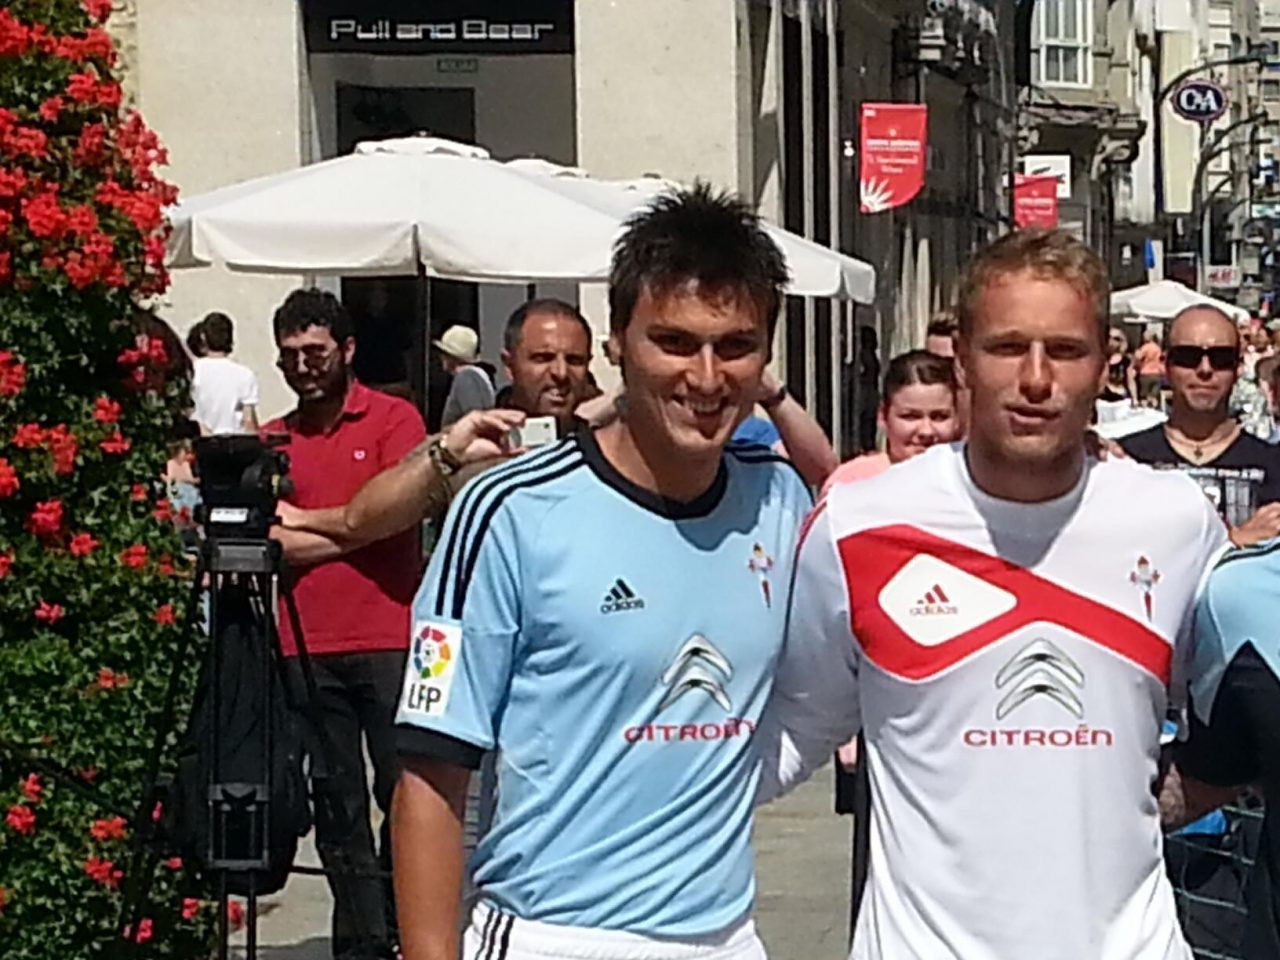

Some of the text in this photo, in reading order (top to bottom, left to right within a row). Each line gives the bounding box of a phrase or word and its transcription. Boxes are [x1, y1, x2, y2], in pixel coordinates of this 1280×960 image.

[331, 20, 554, 39] Pull and Bear
[600, 598, 645, 614] adidas
[408, 683, 443, 713] LFP
